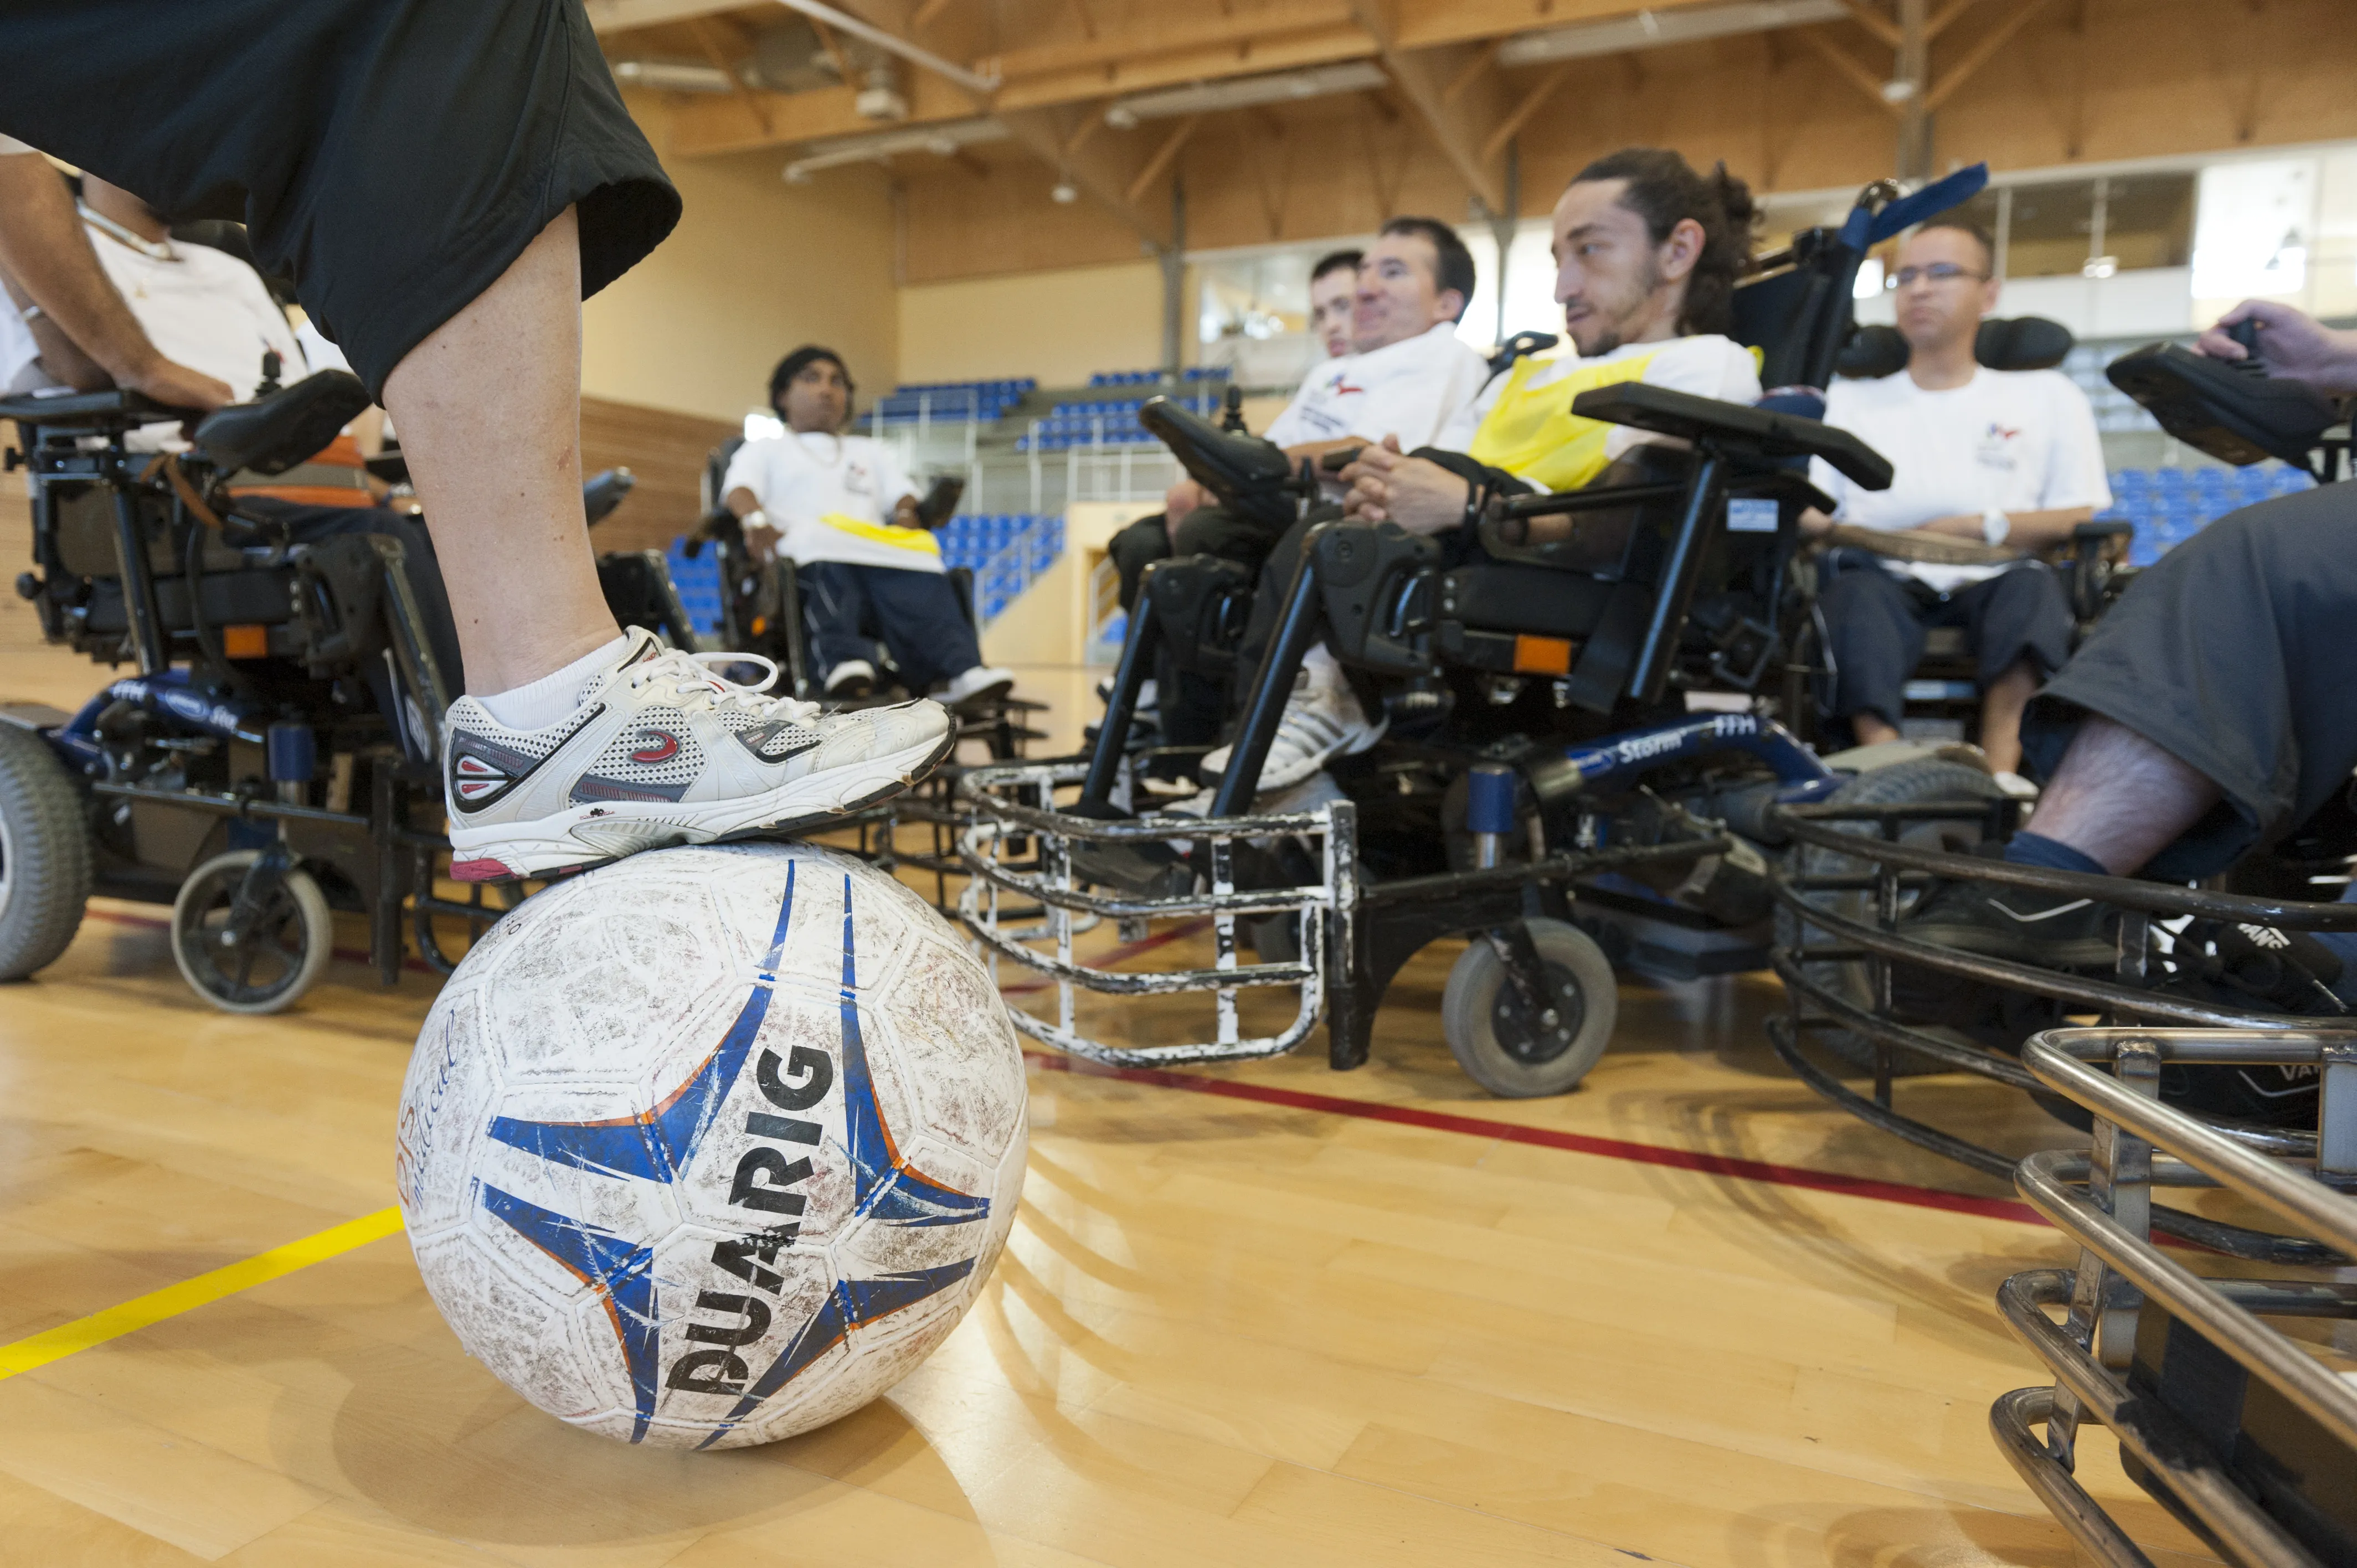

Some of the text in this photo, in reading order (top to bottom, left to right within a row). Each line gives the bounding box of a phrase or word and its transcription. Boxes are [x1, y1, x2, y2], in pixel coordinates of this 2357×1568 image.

[1618, 730, 1684, 764] Storm
[414, 1009, 460, 1210] medical
[666, 1045, 833, 1396] DUARIG
